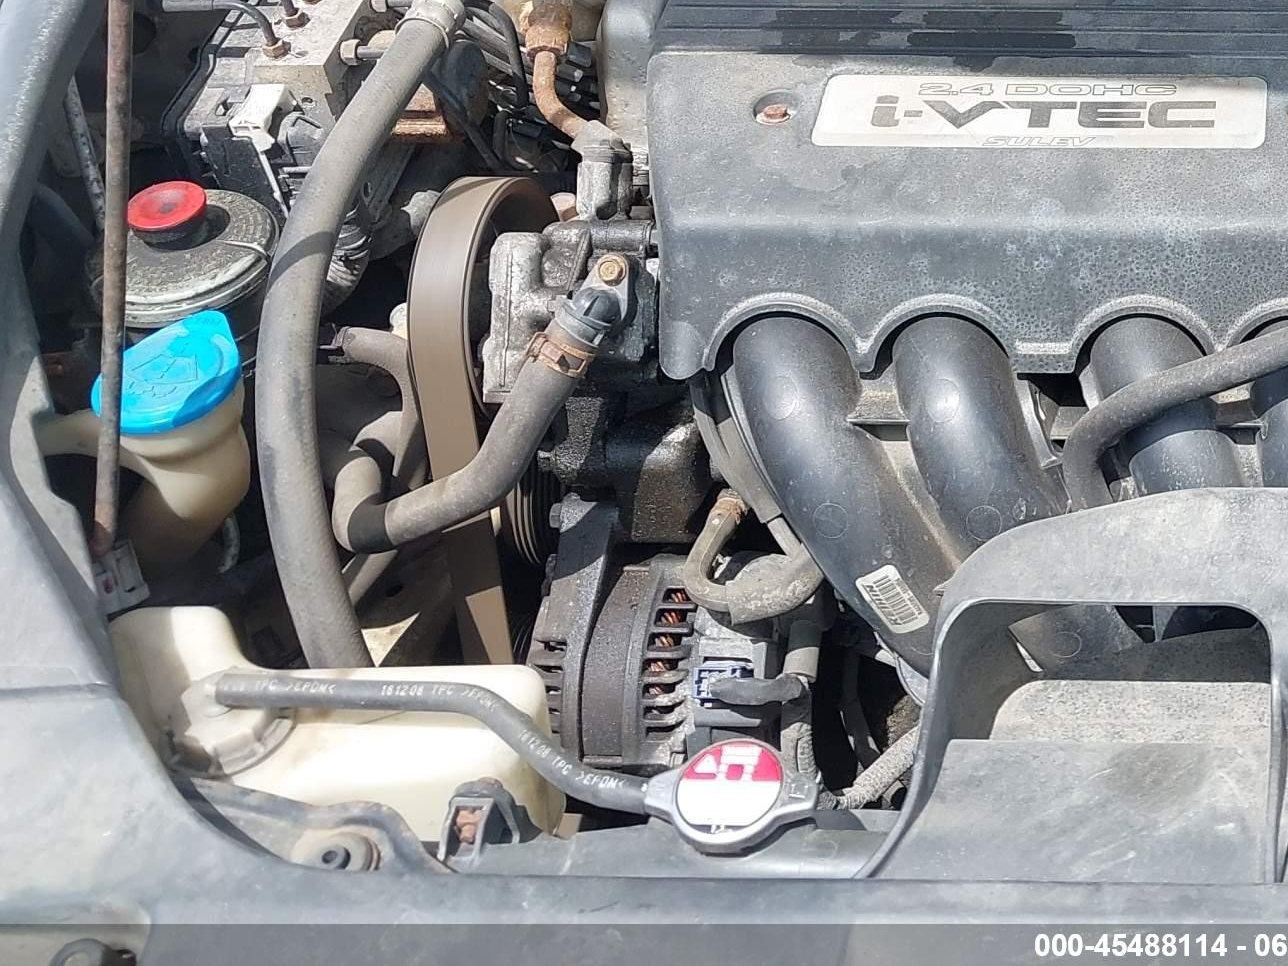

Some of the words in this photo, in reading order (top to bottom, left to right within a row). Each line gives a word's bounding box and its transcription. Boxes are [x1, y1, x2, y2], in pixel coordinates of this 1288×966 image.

[918, 82, 993, 96] 2.4
[1005, 83, 1177, 96] DOHC
[871, 94, 1216, 130] i-VTEC
